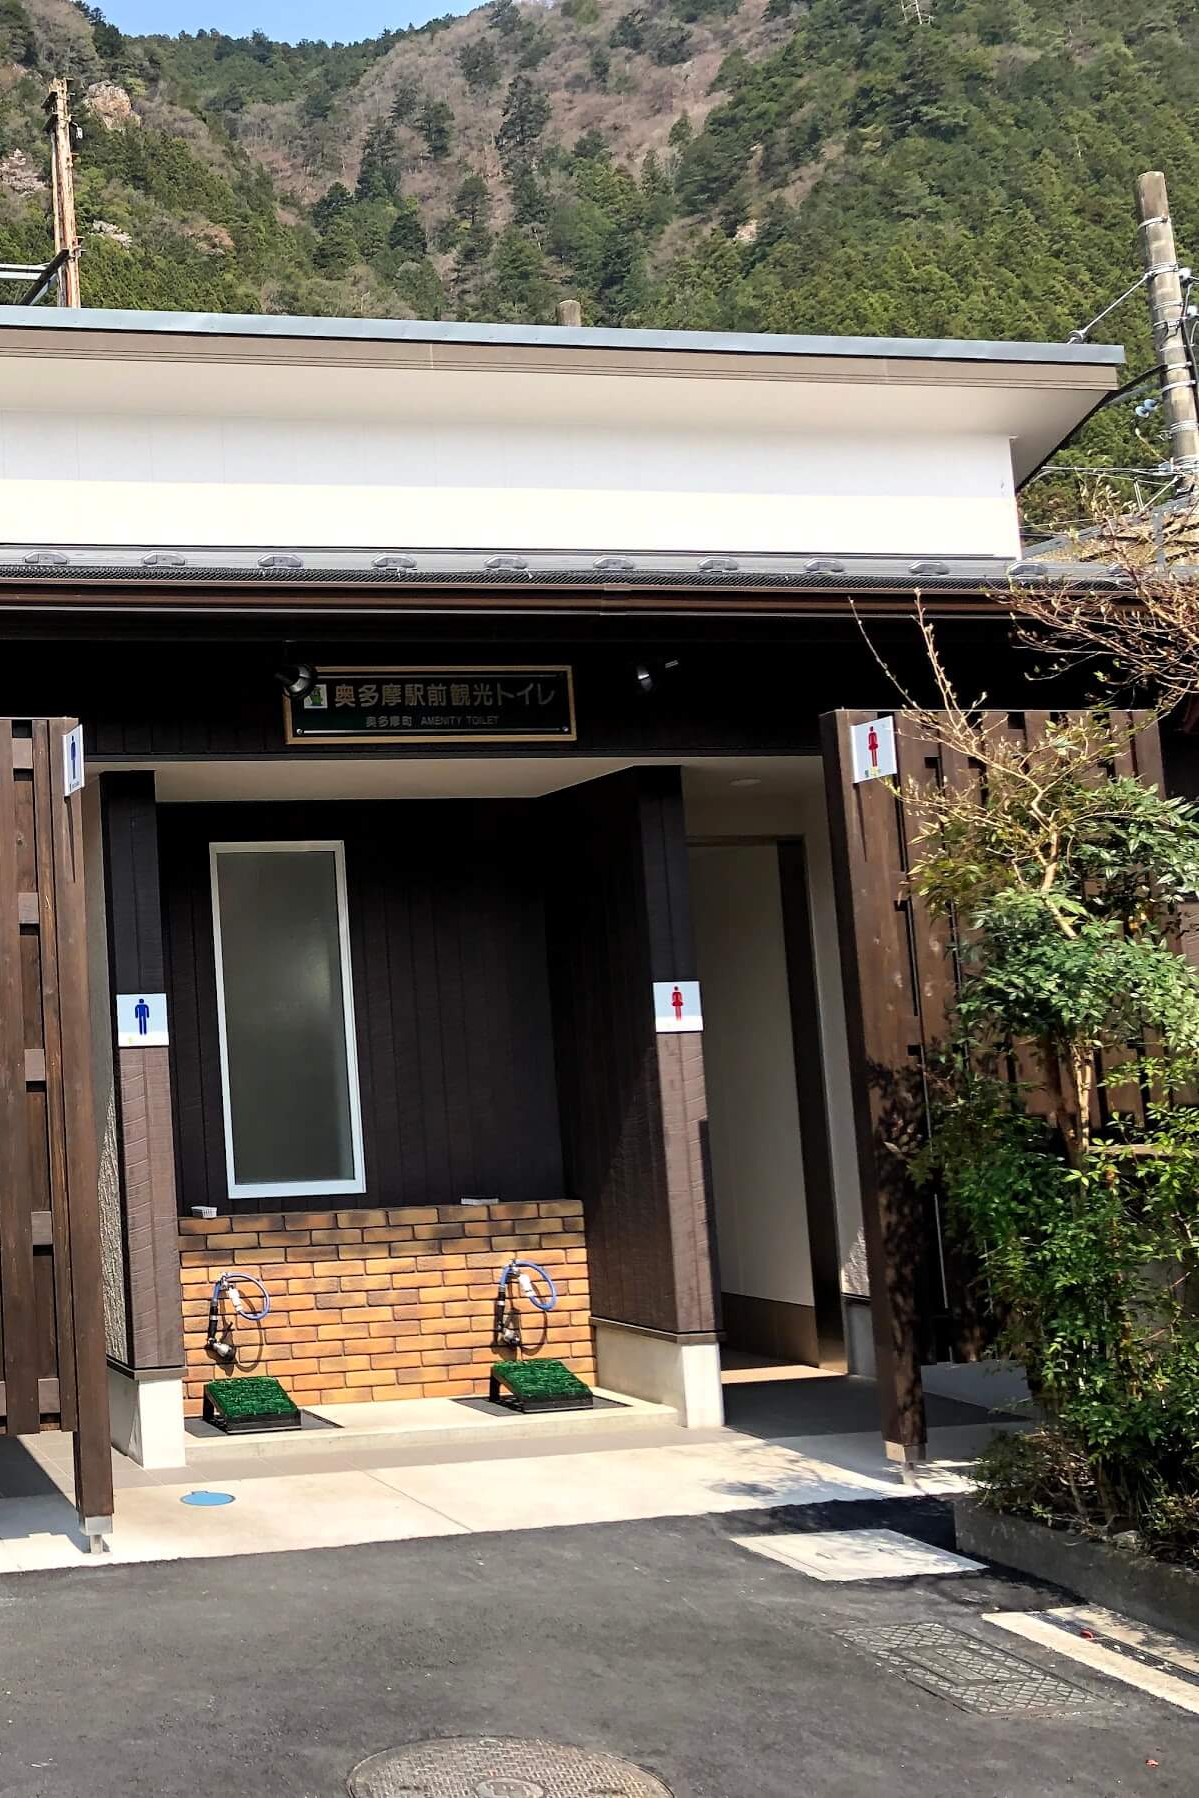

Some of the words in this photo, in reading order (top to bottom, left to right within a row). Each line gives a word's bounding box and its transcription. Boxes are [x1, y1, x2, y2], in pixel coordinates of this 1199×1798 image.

[335, 683, 554, 707] 奥多摩駅前観光トイレ
[420, 715, 463, 727] AMENITY
[465, 715, 500, 726] TOILET
